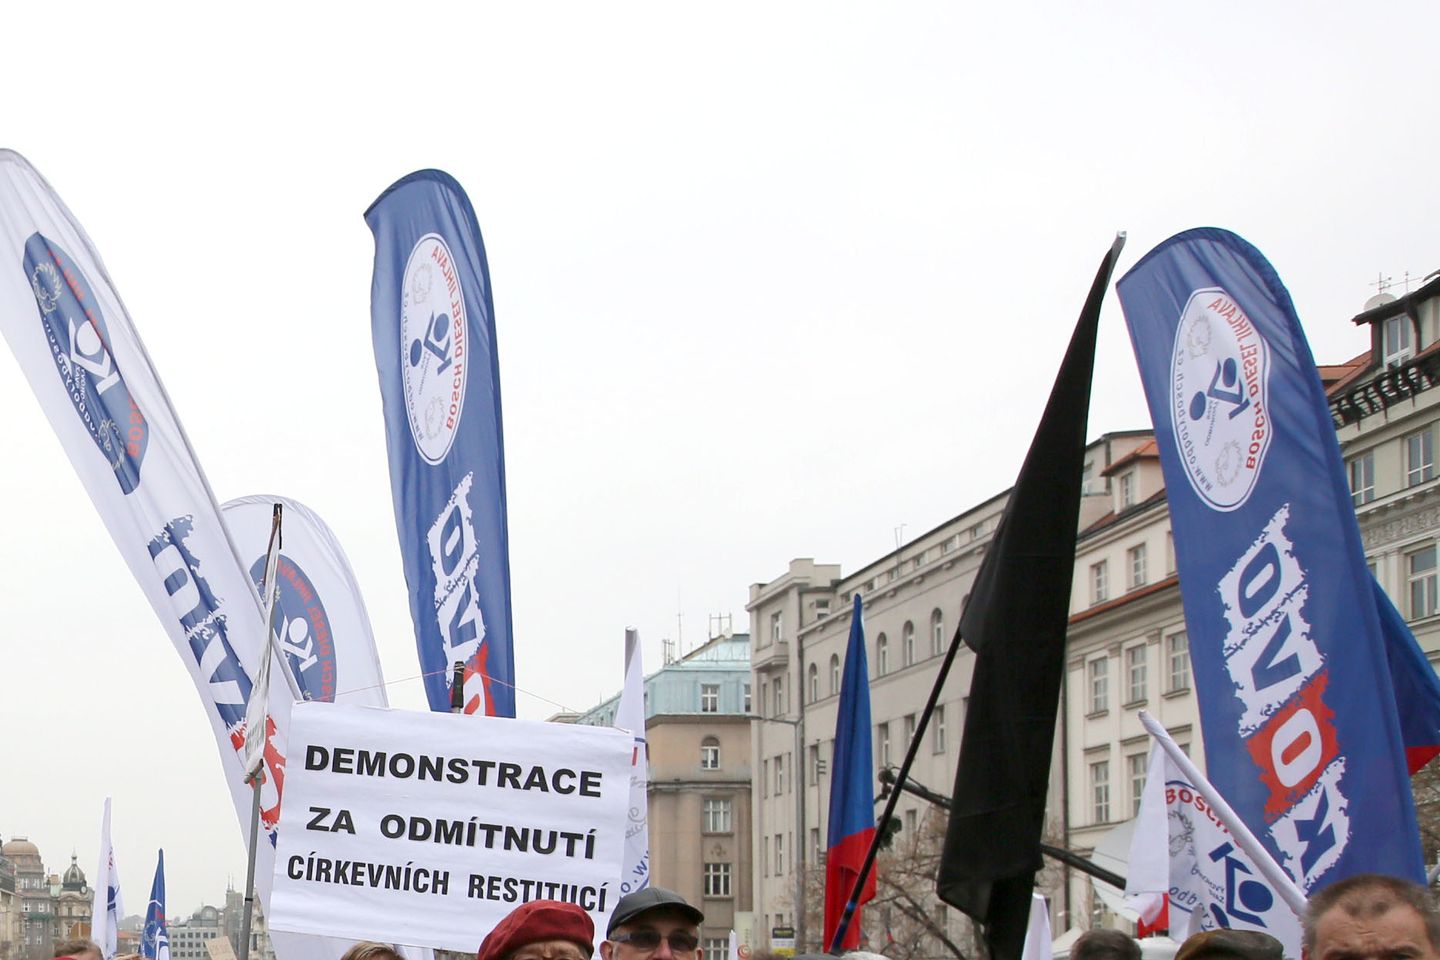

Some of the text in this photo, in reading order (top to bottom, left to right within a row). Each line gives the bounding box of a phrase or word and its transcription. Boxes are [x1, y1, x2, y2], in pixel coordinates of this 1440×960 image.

[304, 745, 602, 798] DEMONSTRACE
[305, 806, 596, 860] ZA ODMÍTNUTÍ
[287, 851, 609, 912] CÍRKEVNÍCH RESTITUCÍ
